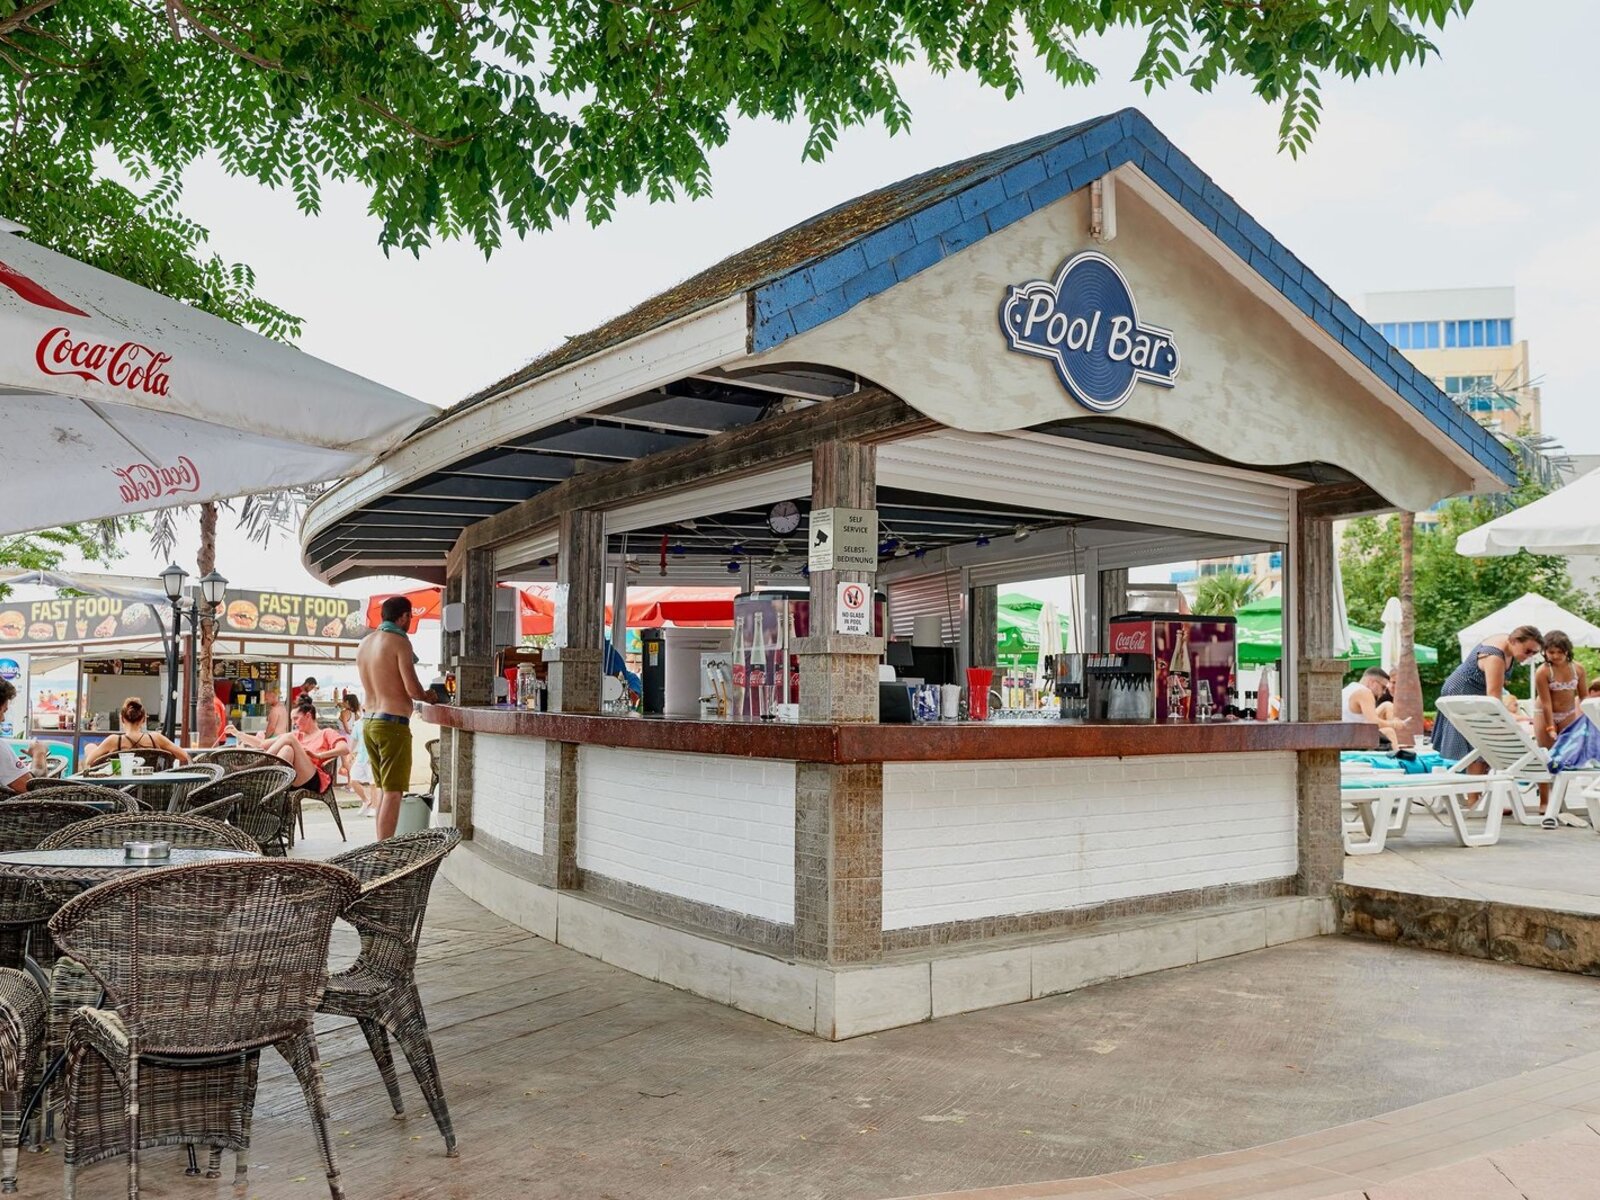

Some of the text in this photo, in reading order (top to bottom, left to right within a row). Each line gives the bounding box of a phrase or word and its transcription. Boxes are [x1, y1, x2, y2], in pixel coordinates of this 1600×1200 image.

[1023, 293, 1168, 369] Pool Bar
[35, 327, 173, 396] Coca-Cola
[843, 525, 868, 534] SERVICE
[837, 555, 874, 565] BEDIENUNG
[31, 597, 122, 621] FAST FOOD
[259, 592, 348, 618] FAST FOOD
